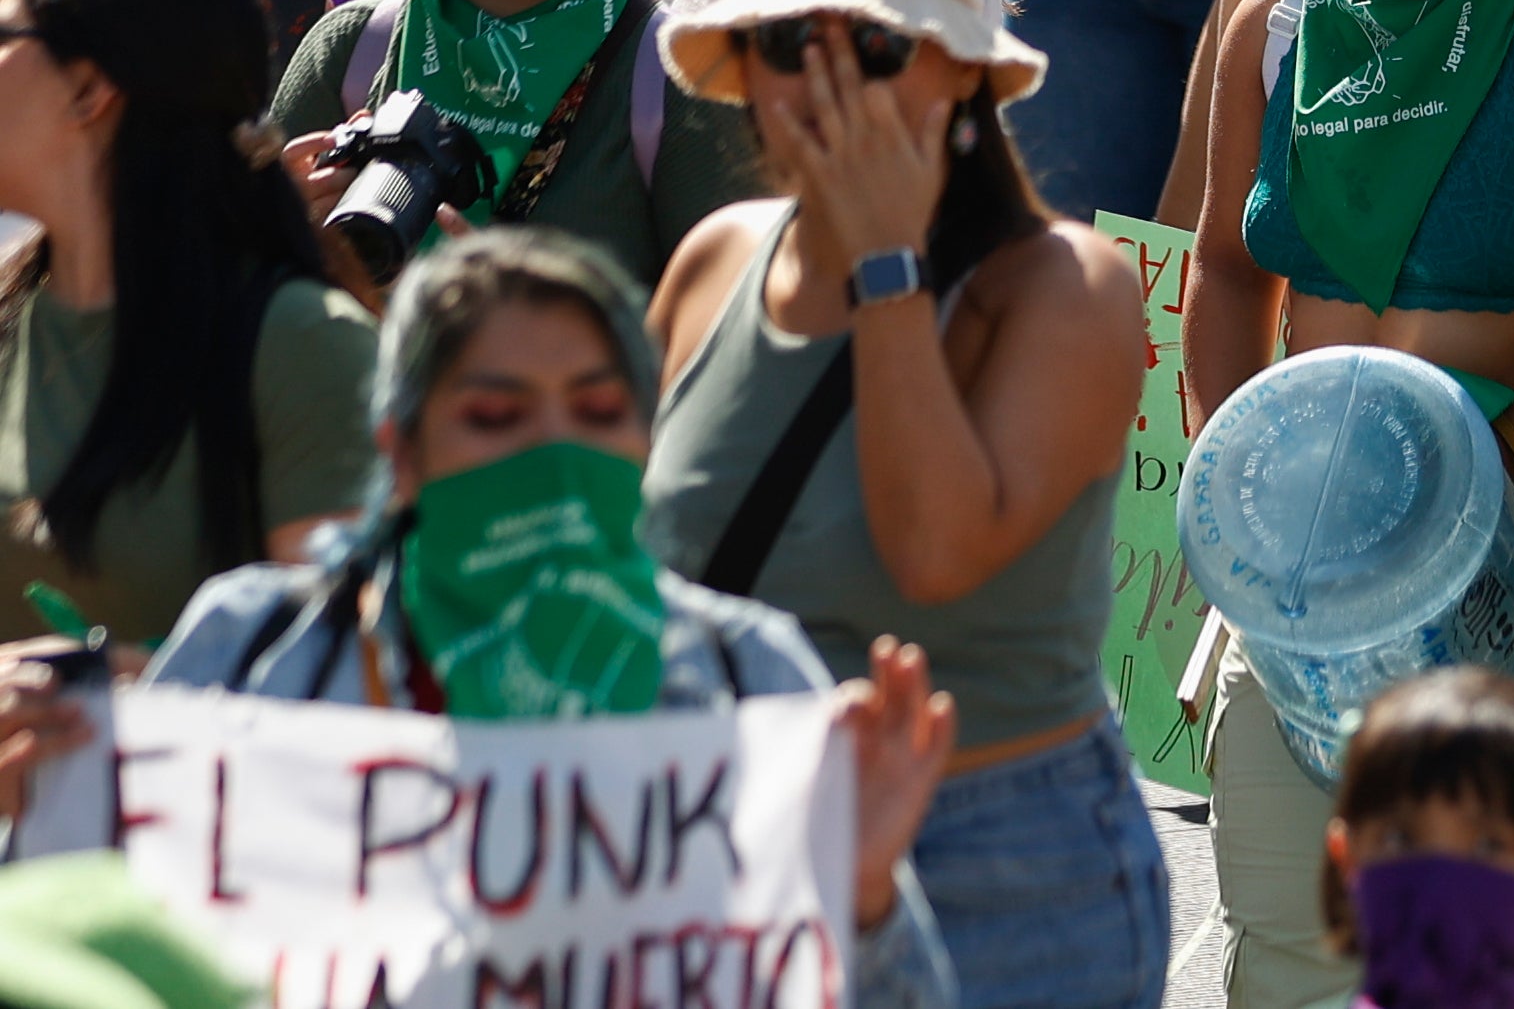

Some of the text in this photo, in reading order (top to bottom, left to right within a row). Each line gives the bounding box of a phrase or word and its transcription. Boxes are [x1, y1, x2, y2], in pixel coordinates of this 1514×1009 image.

[1441, 1, 1473, 74] disfrutar,
[1311, 116, 1350, 138] legal
[1353, 114, 1389, 133] para
[1392, 100, 1449, 123] decidir.
[343, 750, 747, 920] PUNK
